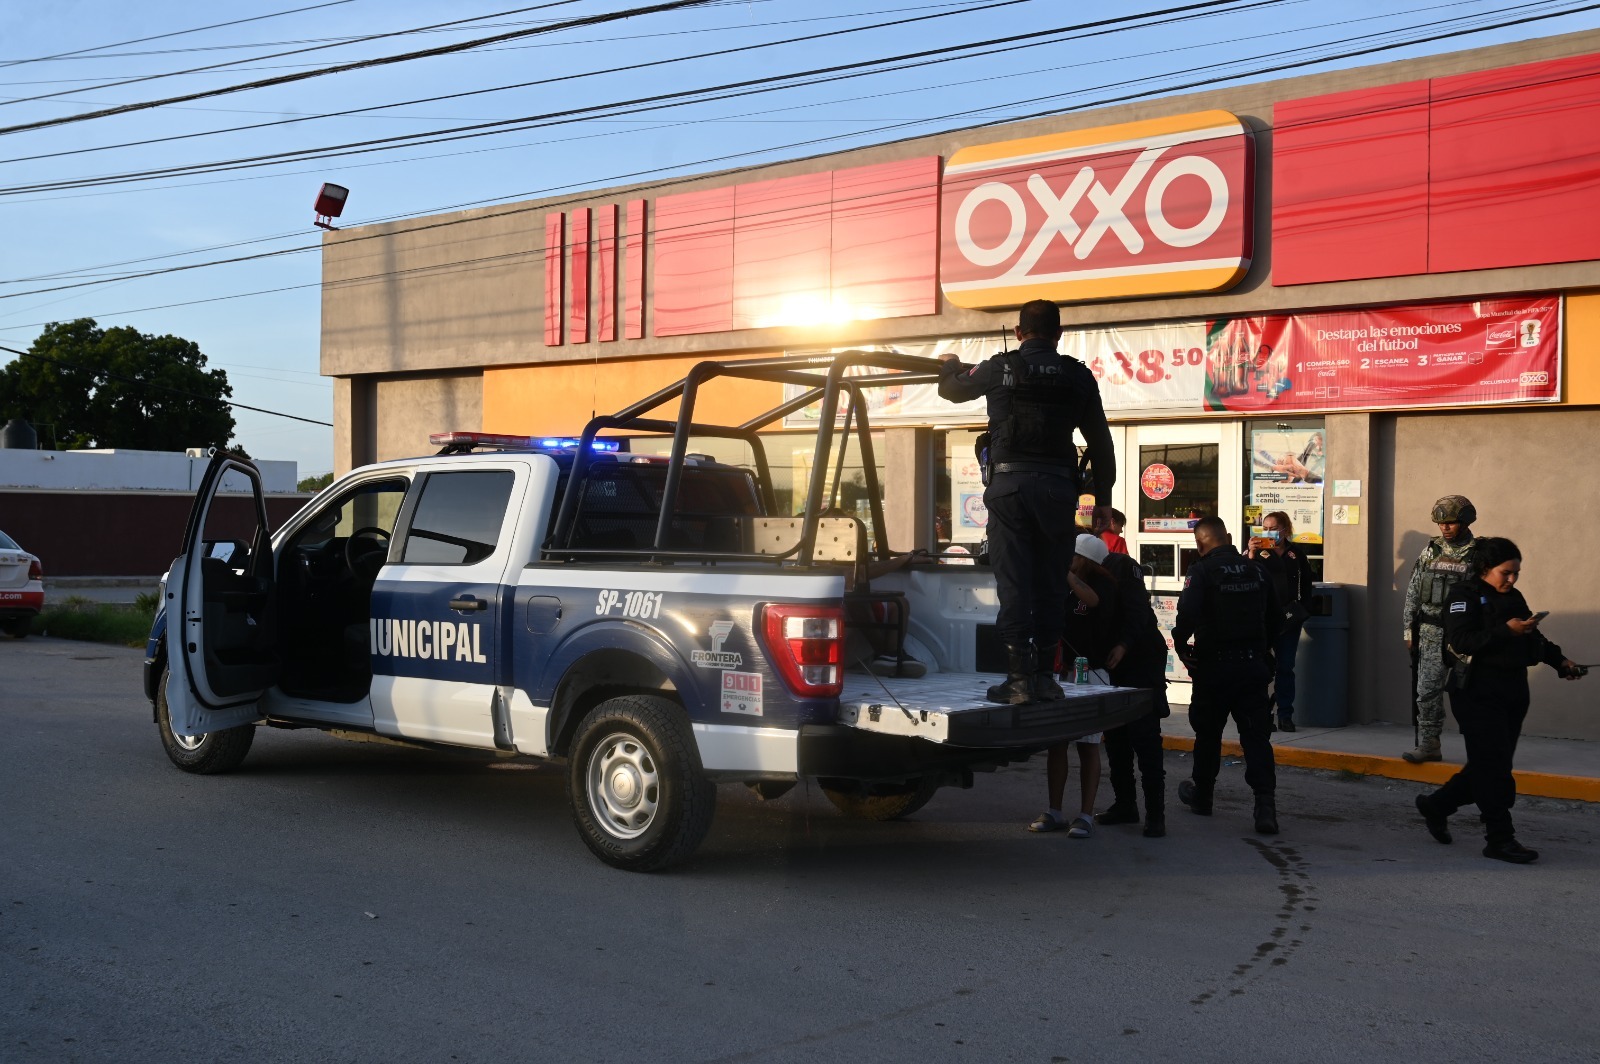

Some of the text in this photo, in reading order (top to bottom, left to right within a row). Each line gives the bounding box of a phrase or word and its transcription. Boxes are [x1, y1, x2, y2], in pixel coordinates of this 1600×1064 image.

[955, 147, 1229, 279] OXXO
[1317, 322, 1462, 342] Destapa las emociones
[1357, 338, 1418, 353] del fútbol
[1360, 358, 1370, 369] 2
[1374, 358, 1409, 366] ESCANEA
[1417, 355, 1428, 366] 3
[1436, 355, 1463, 363] GANAR
[1296, 362, 1303, 373] 1
[1480, 378, 1511, 386] EXCLUSIVO
[1520, 373, 1547, 385] OXXO
[595, 589, 663, 619] SP-1061
[692, 651, 742, 664] FRONTERA
[726, 675, 758, 692] 911
[722, 693, 761, 702] EMERGENCIAS
